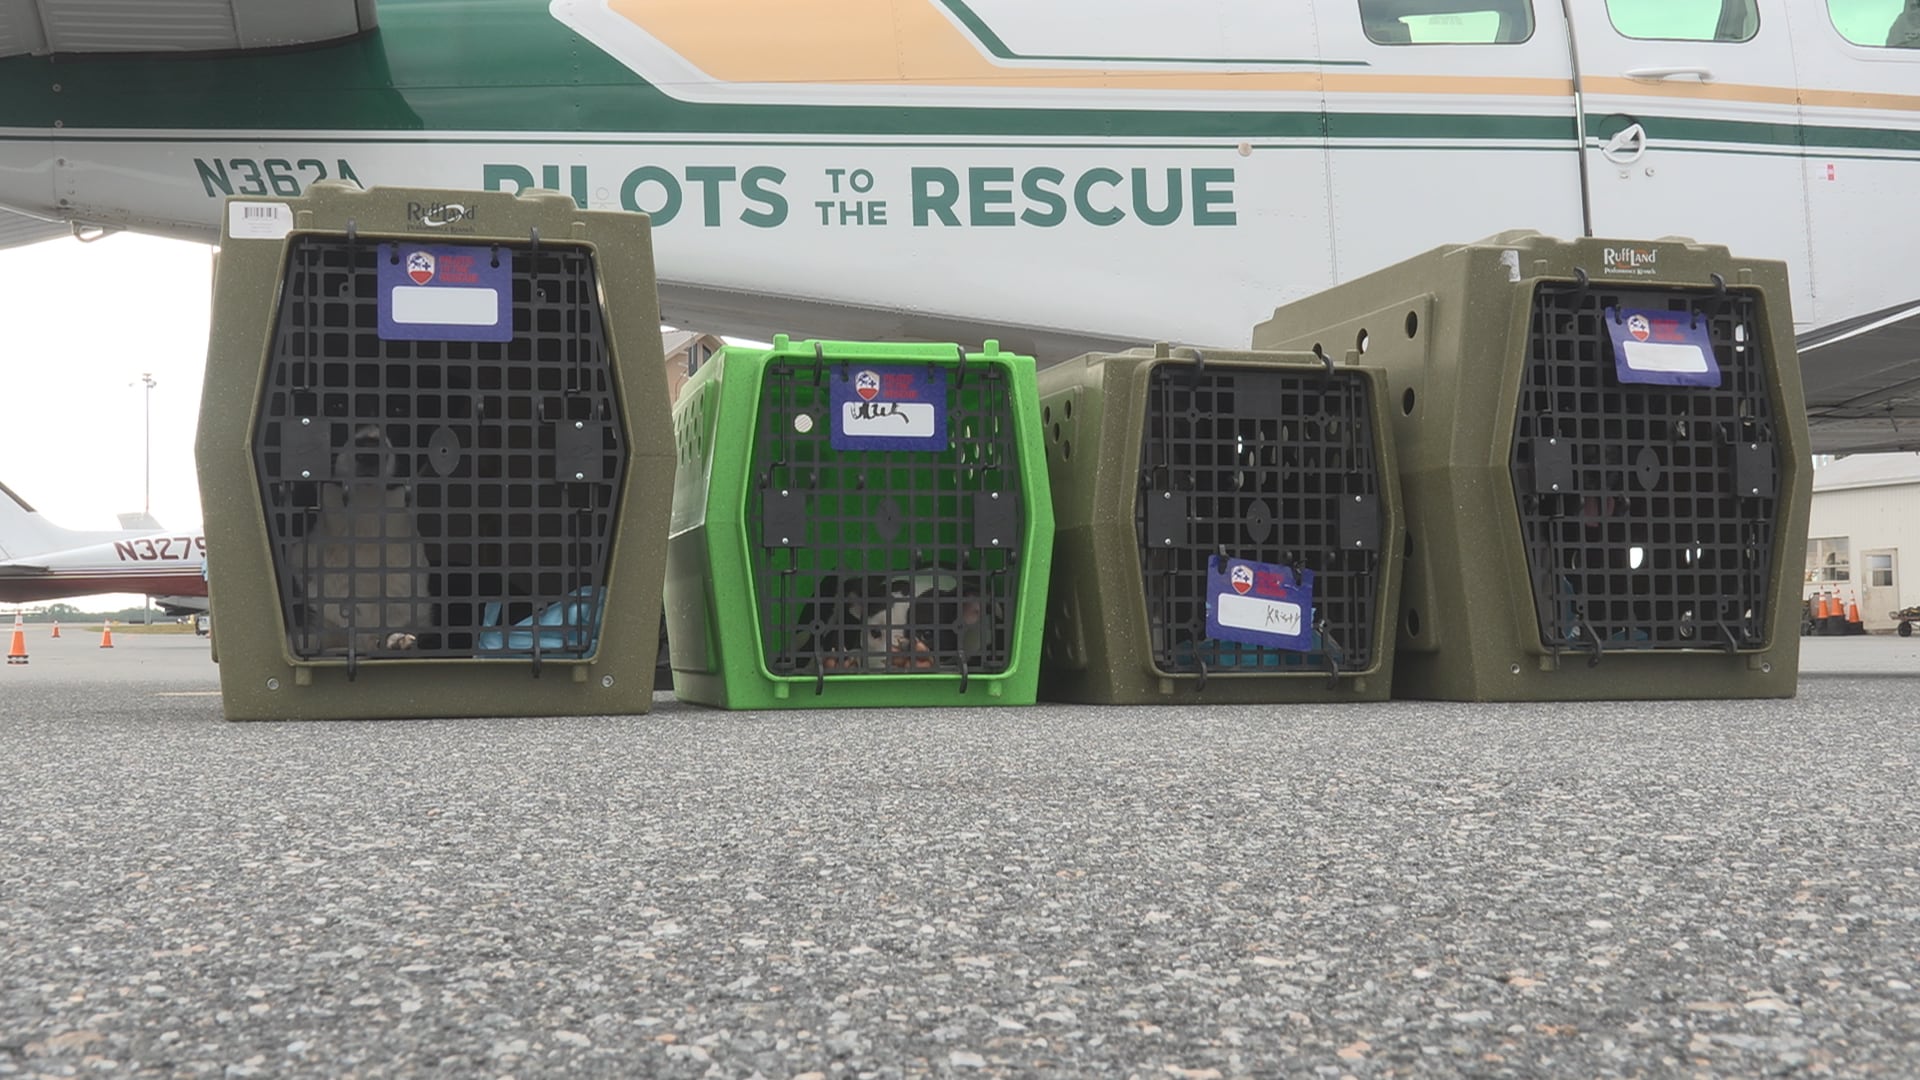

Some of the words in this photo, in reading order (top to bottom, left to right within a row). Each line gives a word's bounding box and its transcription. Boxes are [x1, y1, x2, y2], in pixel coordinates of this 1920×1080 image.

[825, 169, 874, 193] TO
[911, 166, 1237, 228] RESCUE
[815, 201, 887, 225] THE
